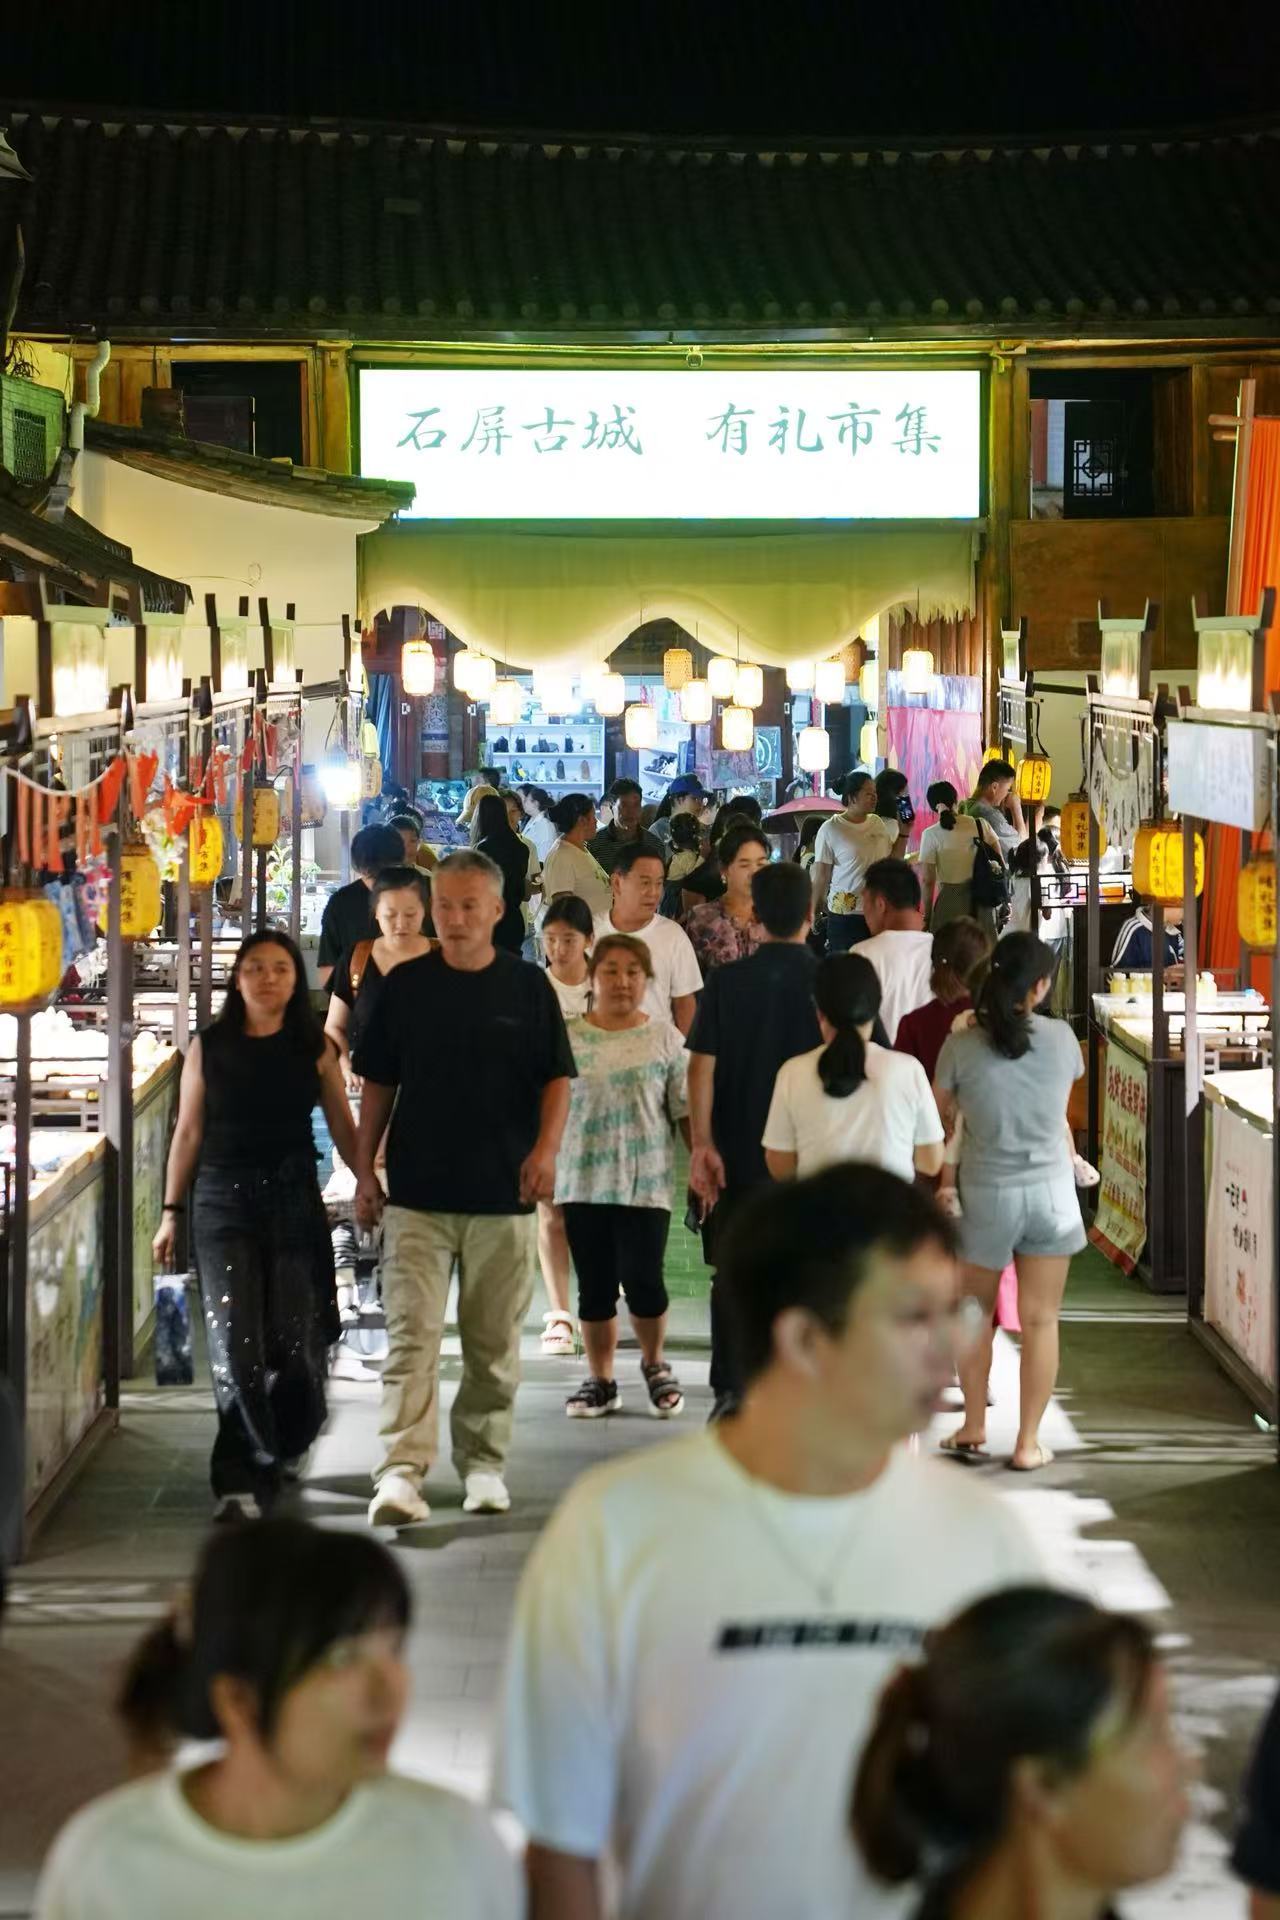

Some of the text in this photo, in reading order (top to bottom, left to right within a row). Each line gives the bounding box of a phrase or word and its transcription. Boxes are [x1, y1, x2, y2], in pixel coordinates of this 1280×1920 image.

[396, 402, 942, 457] 石屏古城 有礼市集
